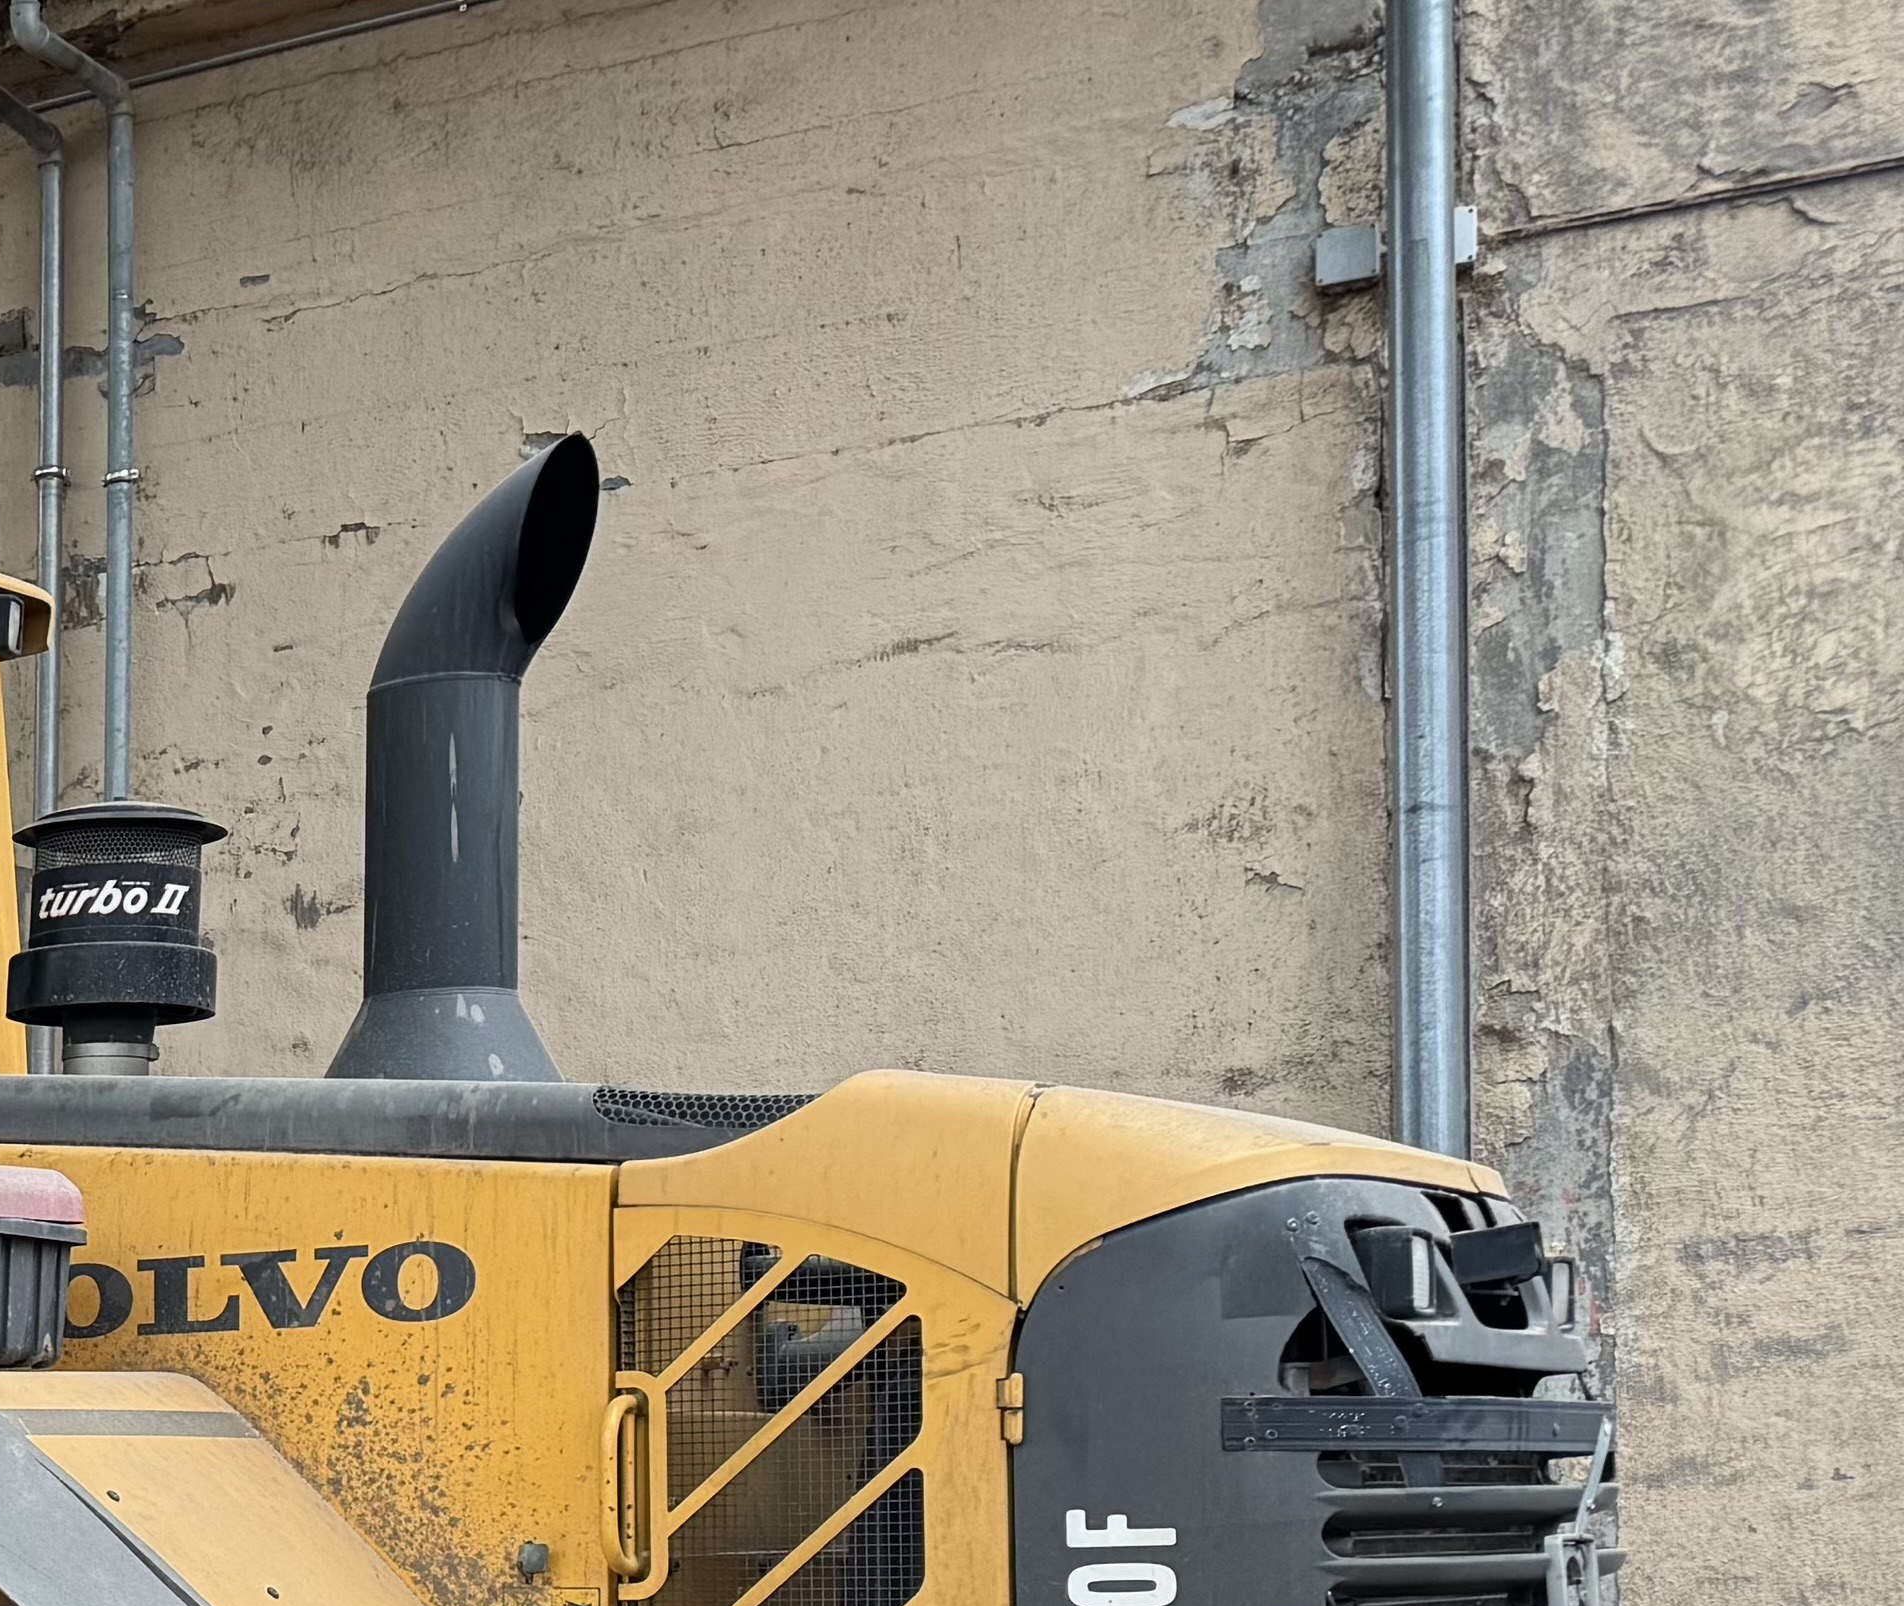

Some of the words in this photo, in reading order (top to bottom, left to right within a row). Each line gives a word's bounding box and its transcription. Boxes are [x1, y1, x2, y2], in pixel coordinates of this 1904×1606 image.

[39, 879, 149, 919] turbo
[150, 883, 190, 915] II
[64, 1240, 476, 1340] OLVO
